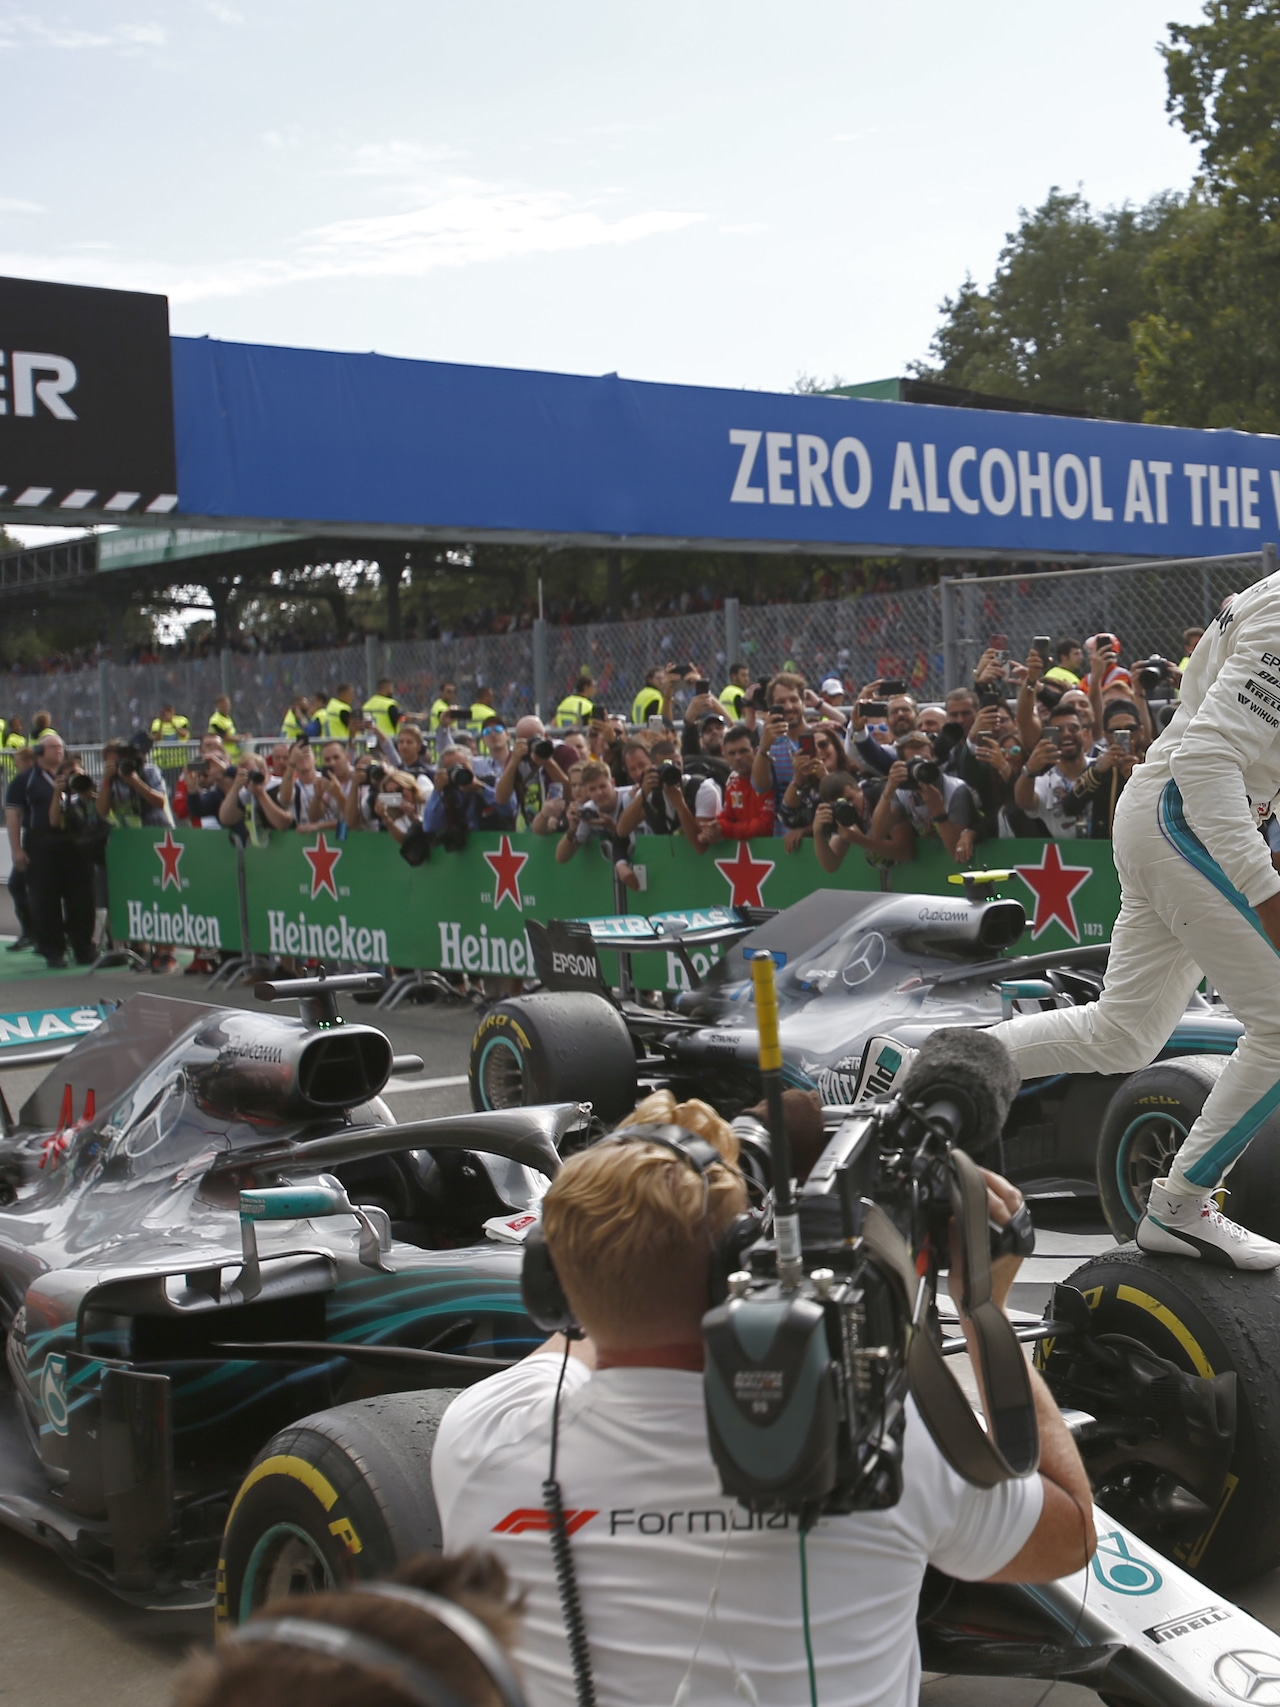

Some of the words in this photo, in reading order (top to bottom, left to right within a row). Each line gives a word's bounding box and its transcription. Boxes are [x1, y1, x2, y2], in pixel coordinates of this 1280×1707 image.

[729, 428, 872, 509] ZERO
[889, 441, 1114, 521] ALCOHOL
[1123, 459, 1173, 525] AT
[1183, 463, 1260, 529] THE
[127, 899, 222, 949] Heineken
[918, 907, 969, 923] Qualcomm
[1082, 923, 1104, 937] 1873
[267, 909, 390, 964] Heineken
[551, 951, 597, 979] EPSON
[225, 1034, 283, 1064] Qualcomm
[609, 1508, 790, 1537] Formula
[1141, 1604, 1235, 1646] PIRELLI
